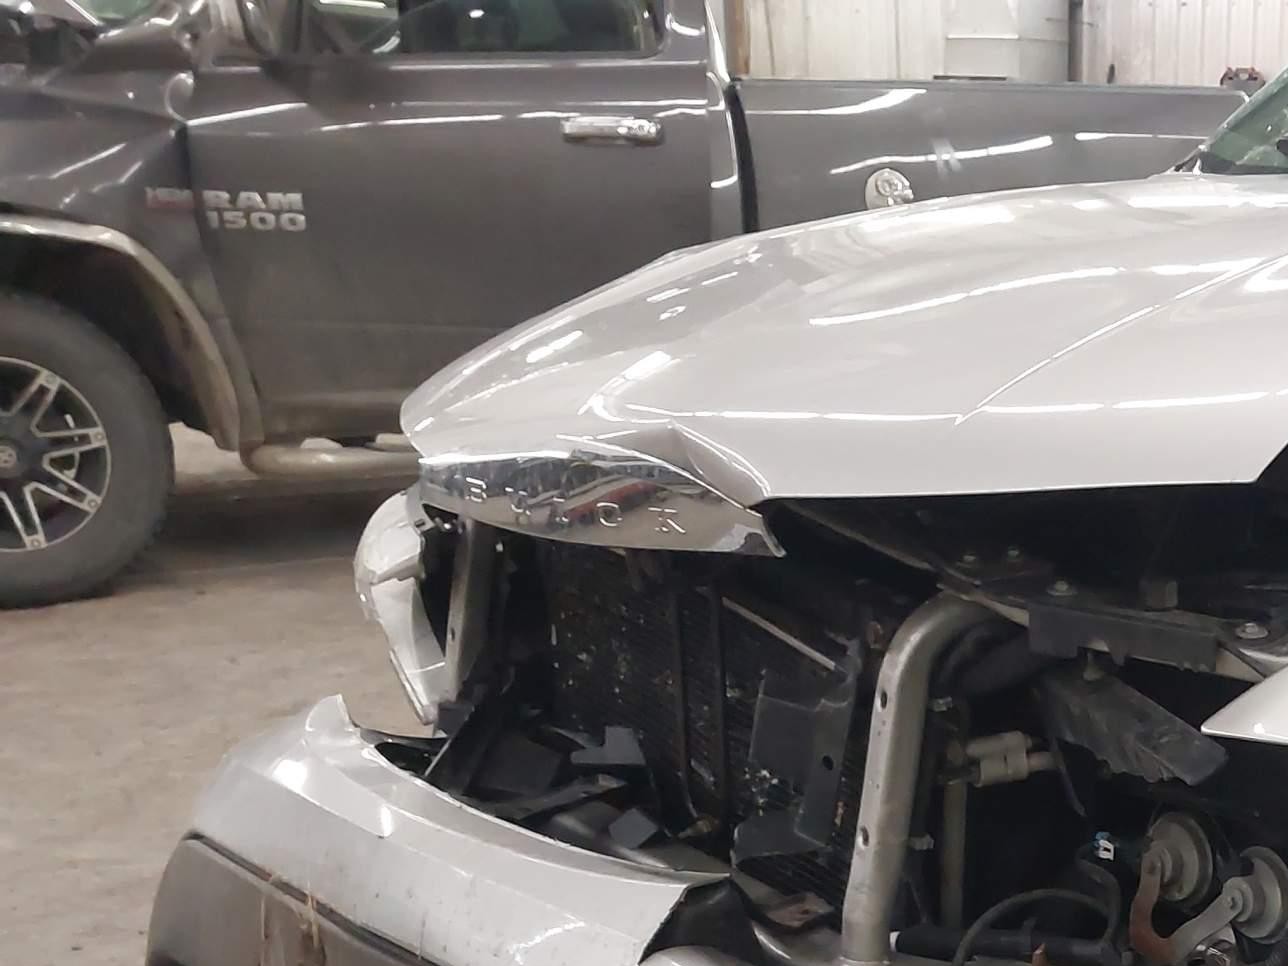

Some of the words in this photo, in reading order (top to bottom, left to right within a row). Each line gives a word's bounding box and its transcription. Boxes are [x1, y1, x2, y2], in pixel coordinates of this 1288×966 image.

[203, 190, 304, 210] RAM
[206, 210, 306, 231] 1500
[464, 475, 687, 534] BUICK
